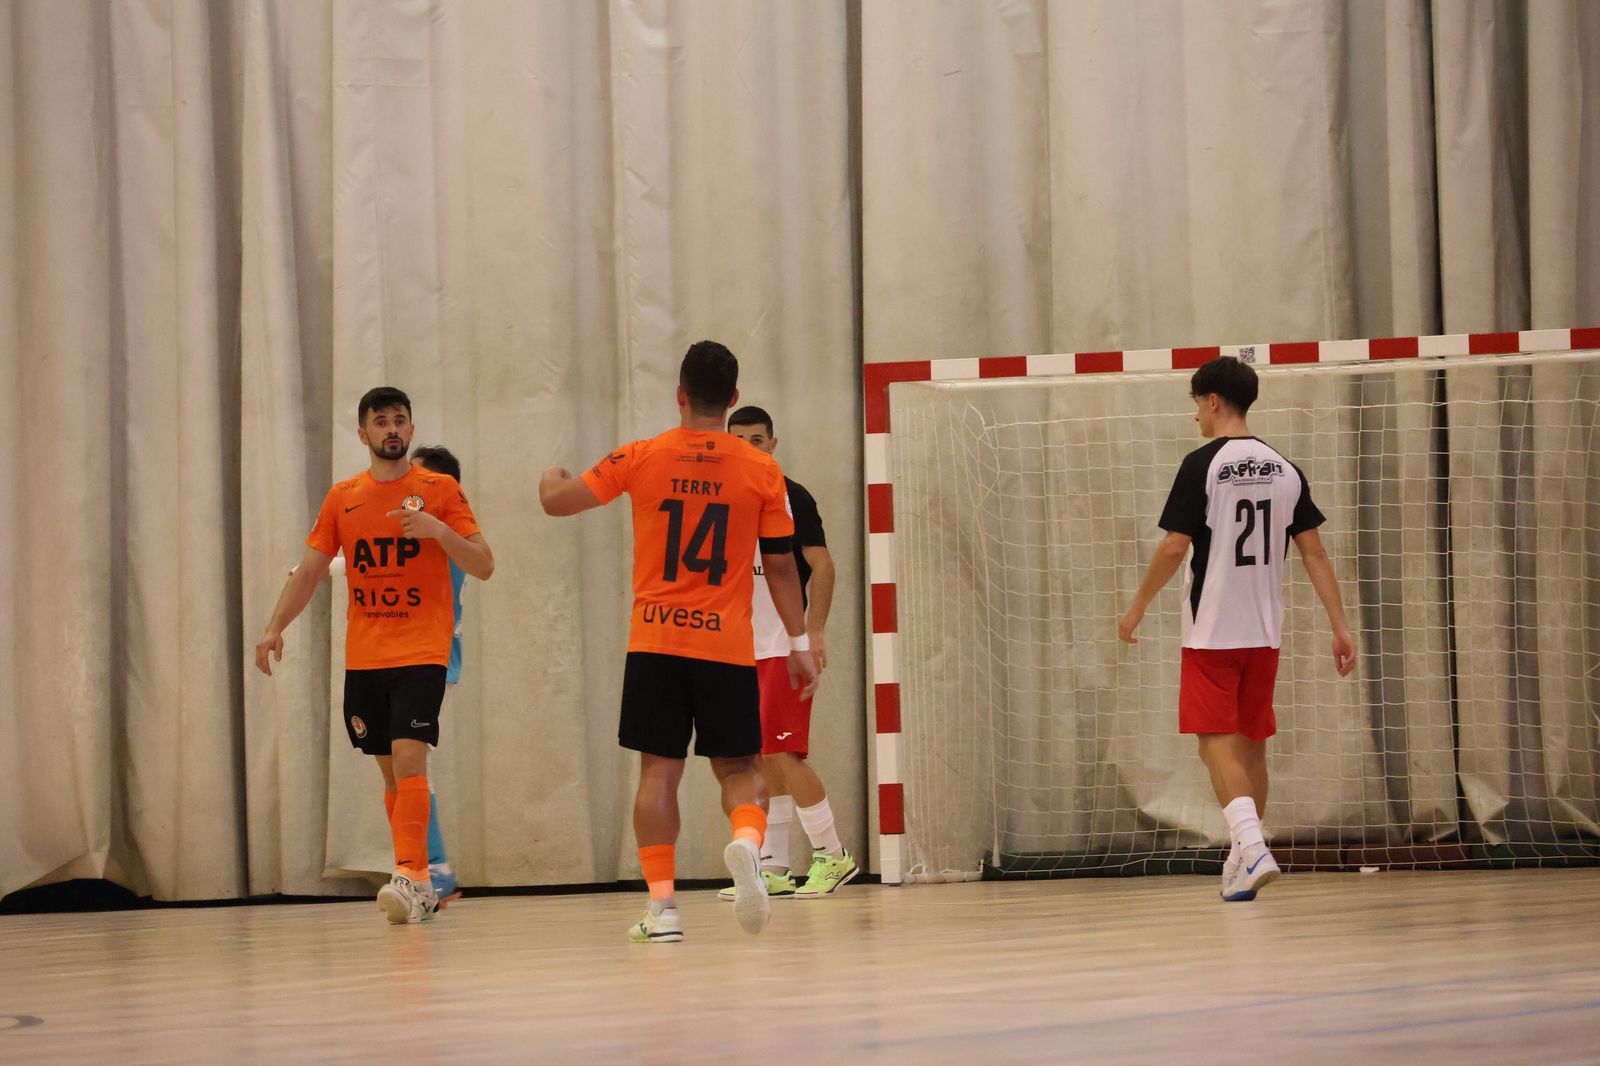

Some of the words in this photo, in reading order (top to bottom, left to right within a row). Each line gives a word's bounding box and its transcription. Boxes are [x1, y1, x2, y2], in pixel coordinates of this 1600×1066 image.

[671, 478, 723, 496] TERRY
[658, 498, 730, 587] 14
[1235, 498, 1272, 567] 21
[352, 537, 421, 569] ATP
[364, 610, 409, 618] renovables
[642, 603, 721, 631] uvesa
